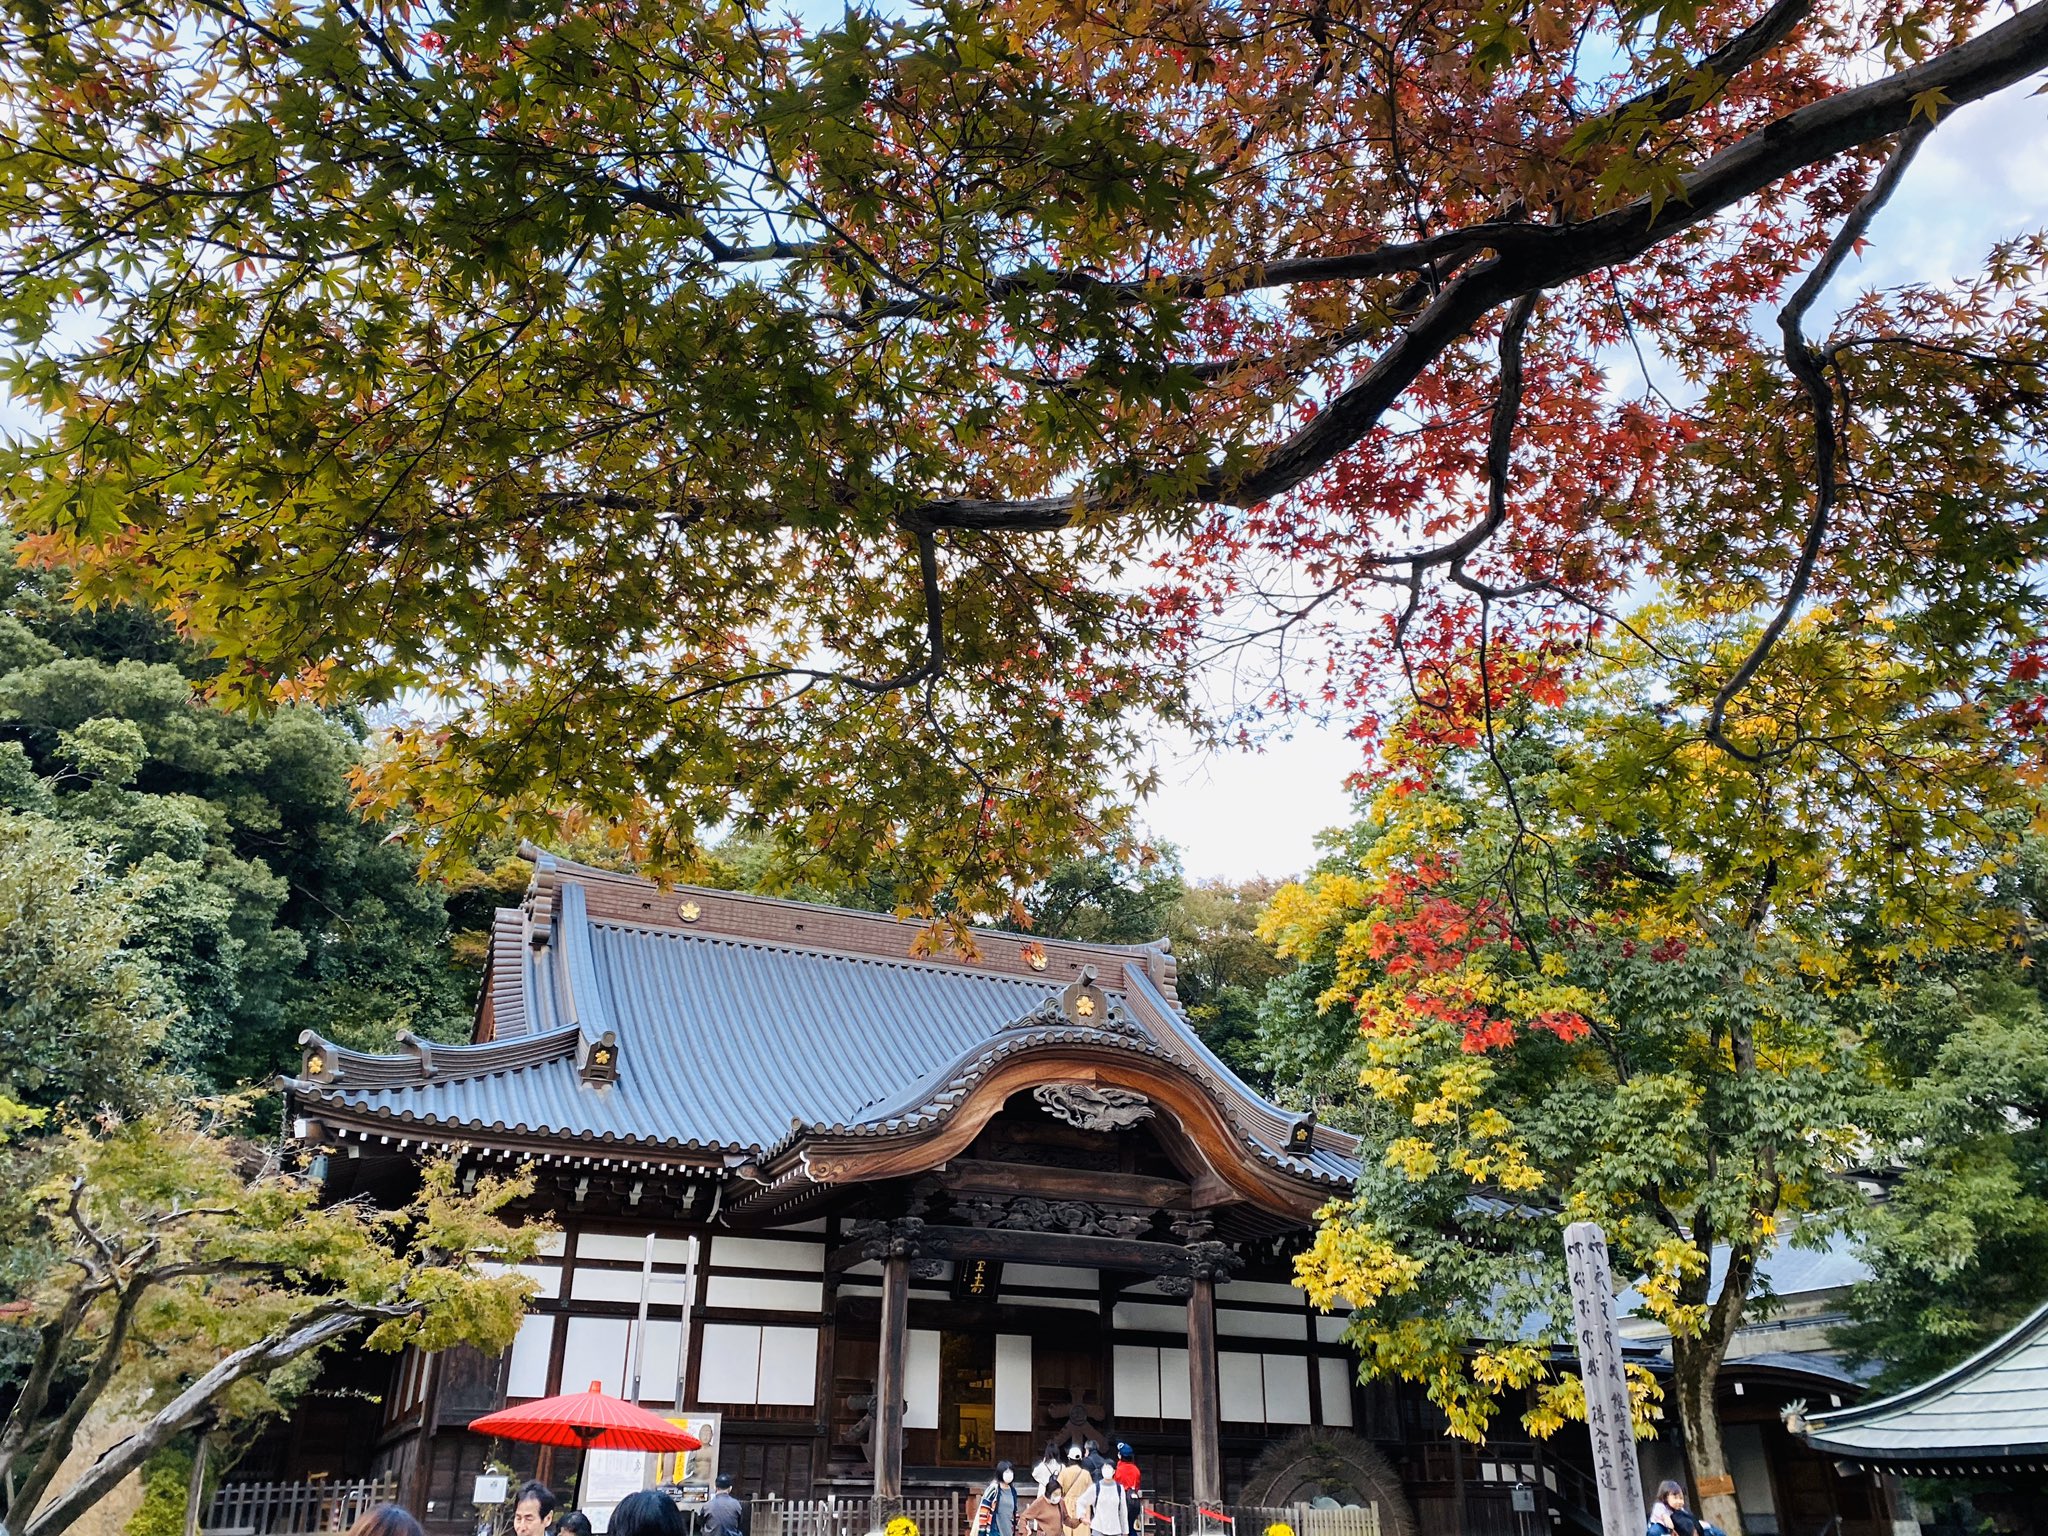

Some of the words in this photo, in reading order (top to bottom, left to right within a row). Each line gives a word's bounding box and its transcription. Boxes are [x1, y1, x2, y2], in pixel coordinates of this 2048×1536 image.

[1610, 1391, 1640, 1513] 維時平成二十九
